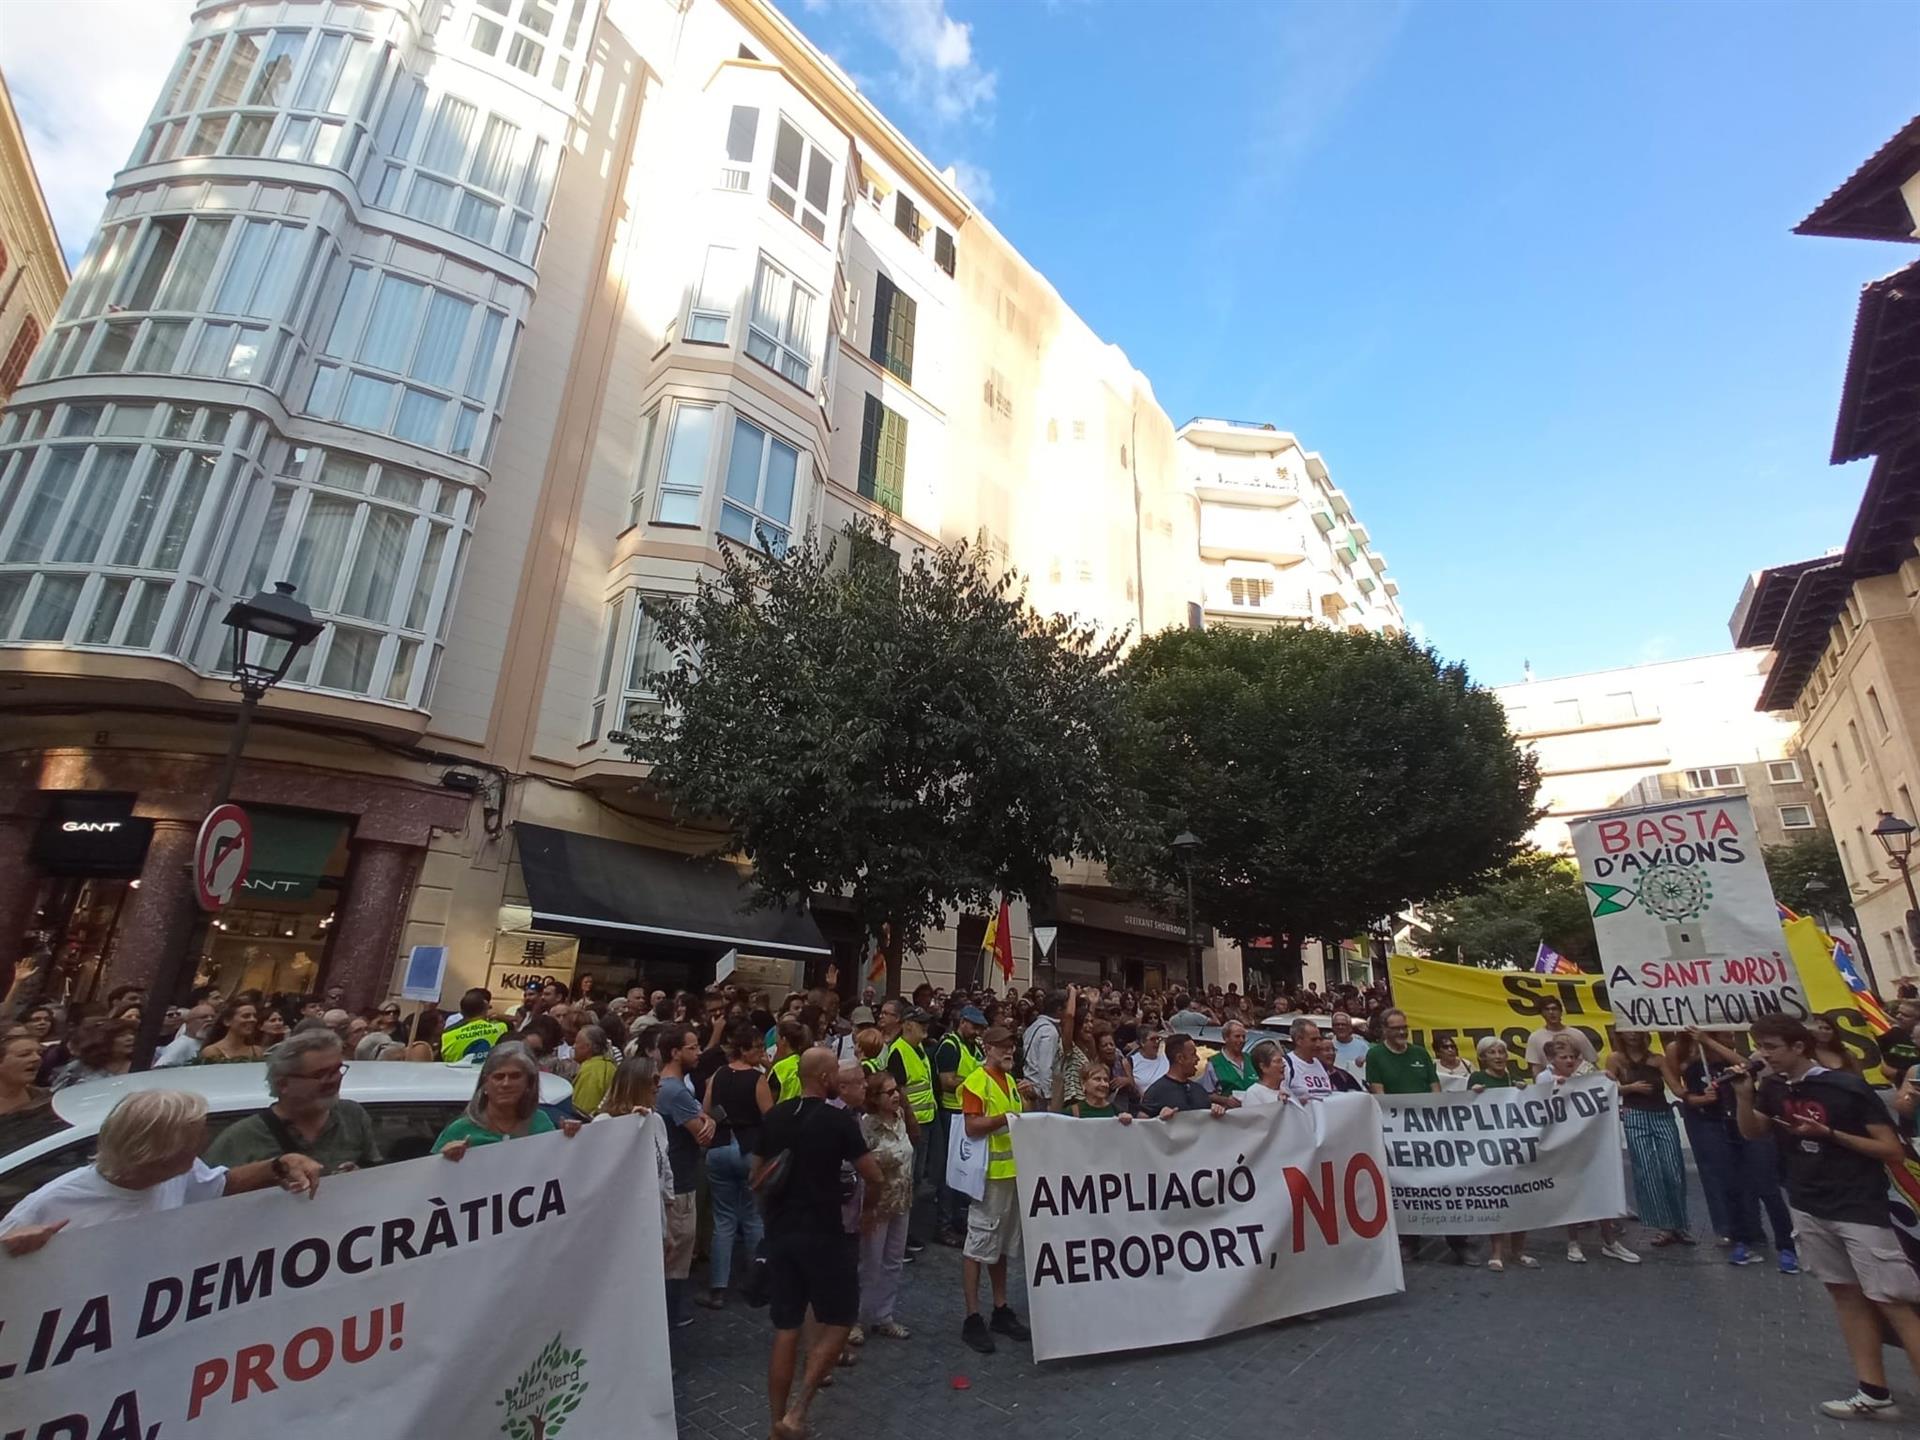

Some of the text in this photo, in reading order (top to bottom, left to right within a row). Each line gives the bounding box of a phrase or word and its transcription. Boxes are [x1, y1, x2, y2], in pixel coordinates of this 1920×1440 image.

[62, 821, 121, 832] GANT
[1598, 809, 1739, 854] BASTA
[1155, 920, 1186, 935] SHOWROOM
[1610, 965, 1637, 989] A
[1641, 959, 1712, 989] SANT
[1615, 995, 1698, 1026] VOLEM
[1570, 1087, 1610, 1118] DE
[1029, 1153, 1256, 1217] AMPLIACIÓ
[1456, 1177, 1554, 1197] D'ASSOCIACIONS
[1282, 1152, 1388, 1254] NO
[1445, 1199, 1463, 1210] DE
[1465, 1198, 1509, 1210] PALMA
[136, 1179, 567, 1339] DEMOCRÀTICA
[1032, 1224, 1277, 1286] AEROPORT,
[186, 1302, 405, 1421] PROU!
